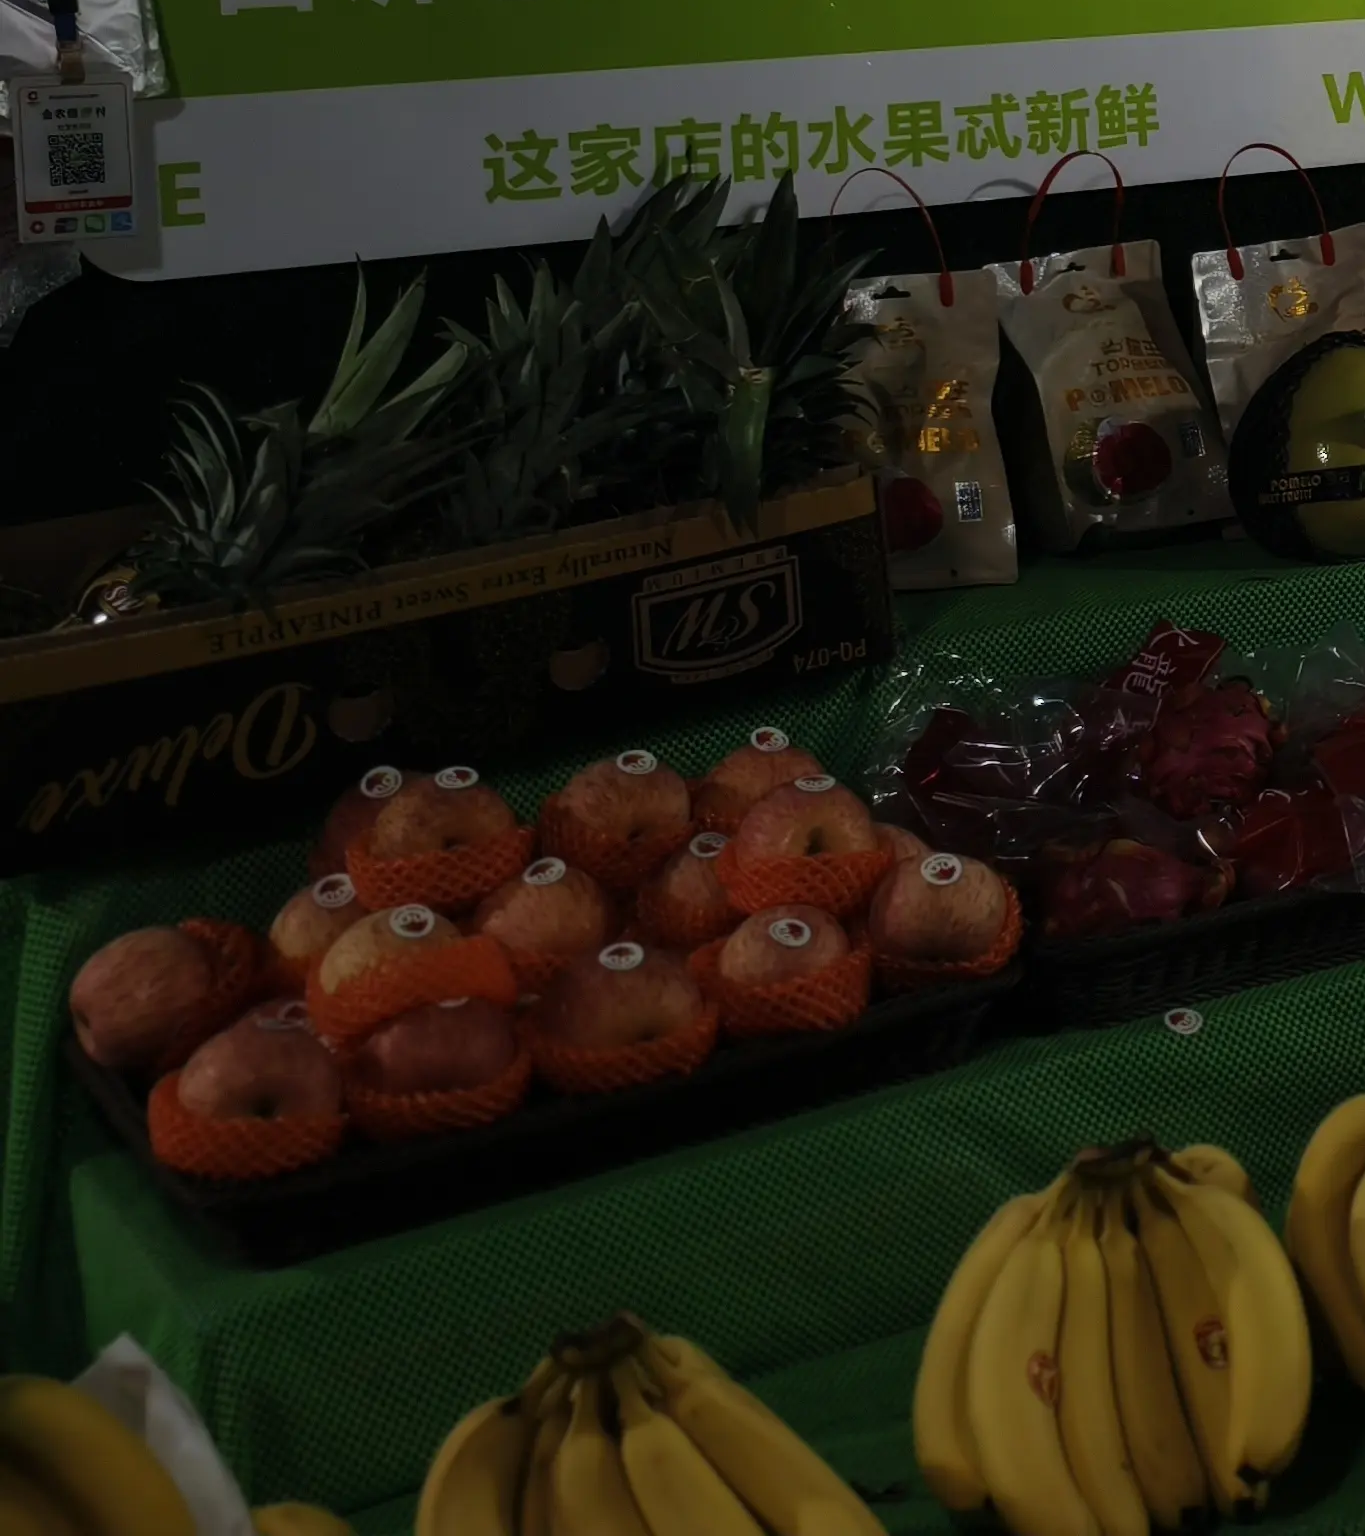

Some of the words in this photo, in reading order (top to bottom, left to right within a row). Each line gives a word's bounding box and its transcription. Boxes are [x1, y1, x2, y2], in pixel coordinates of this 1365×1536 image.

[484, 84, 1159, 205] 这家店的水果忒新鲜
[1065, 377, 1189, 412] POMELO
[481, 561, 547, 592] Extra
[557, 536, 673, 581] Naturally
[396, 581, 470, 612] Sweet
[208, 599, 383, 656] PINEAPPLE
[15, 680, 317, 835] Deluxe
